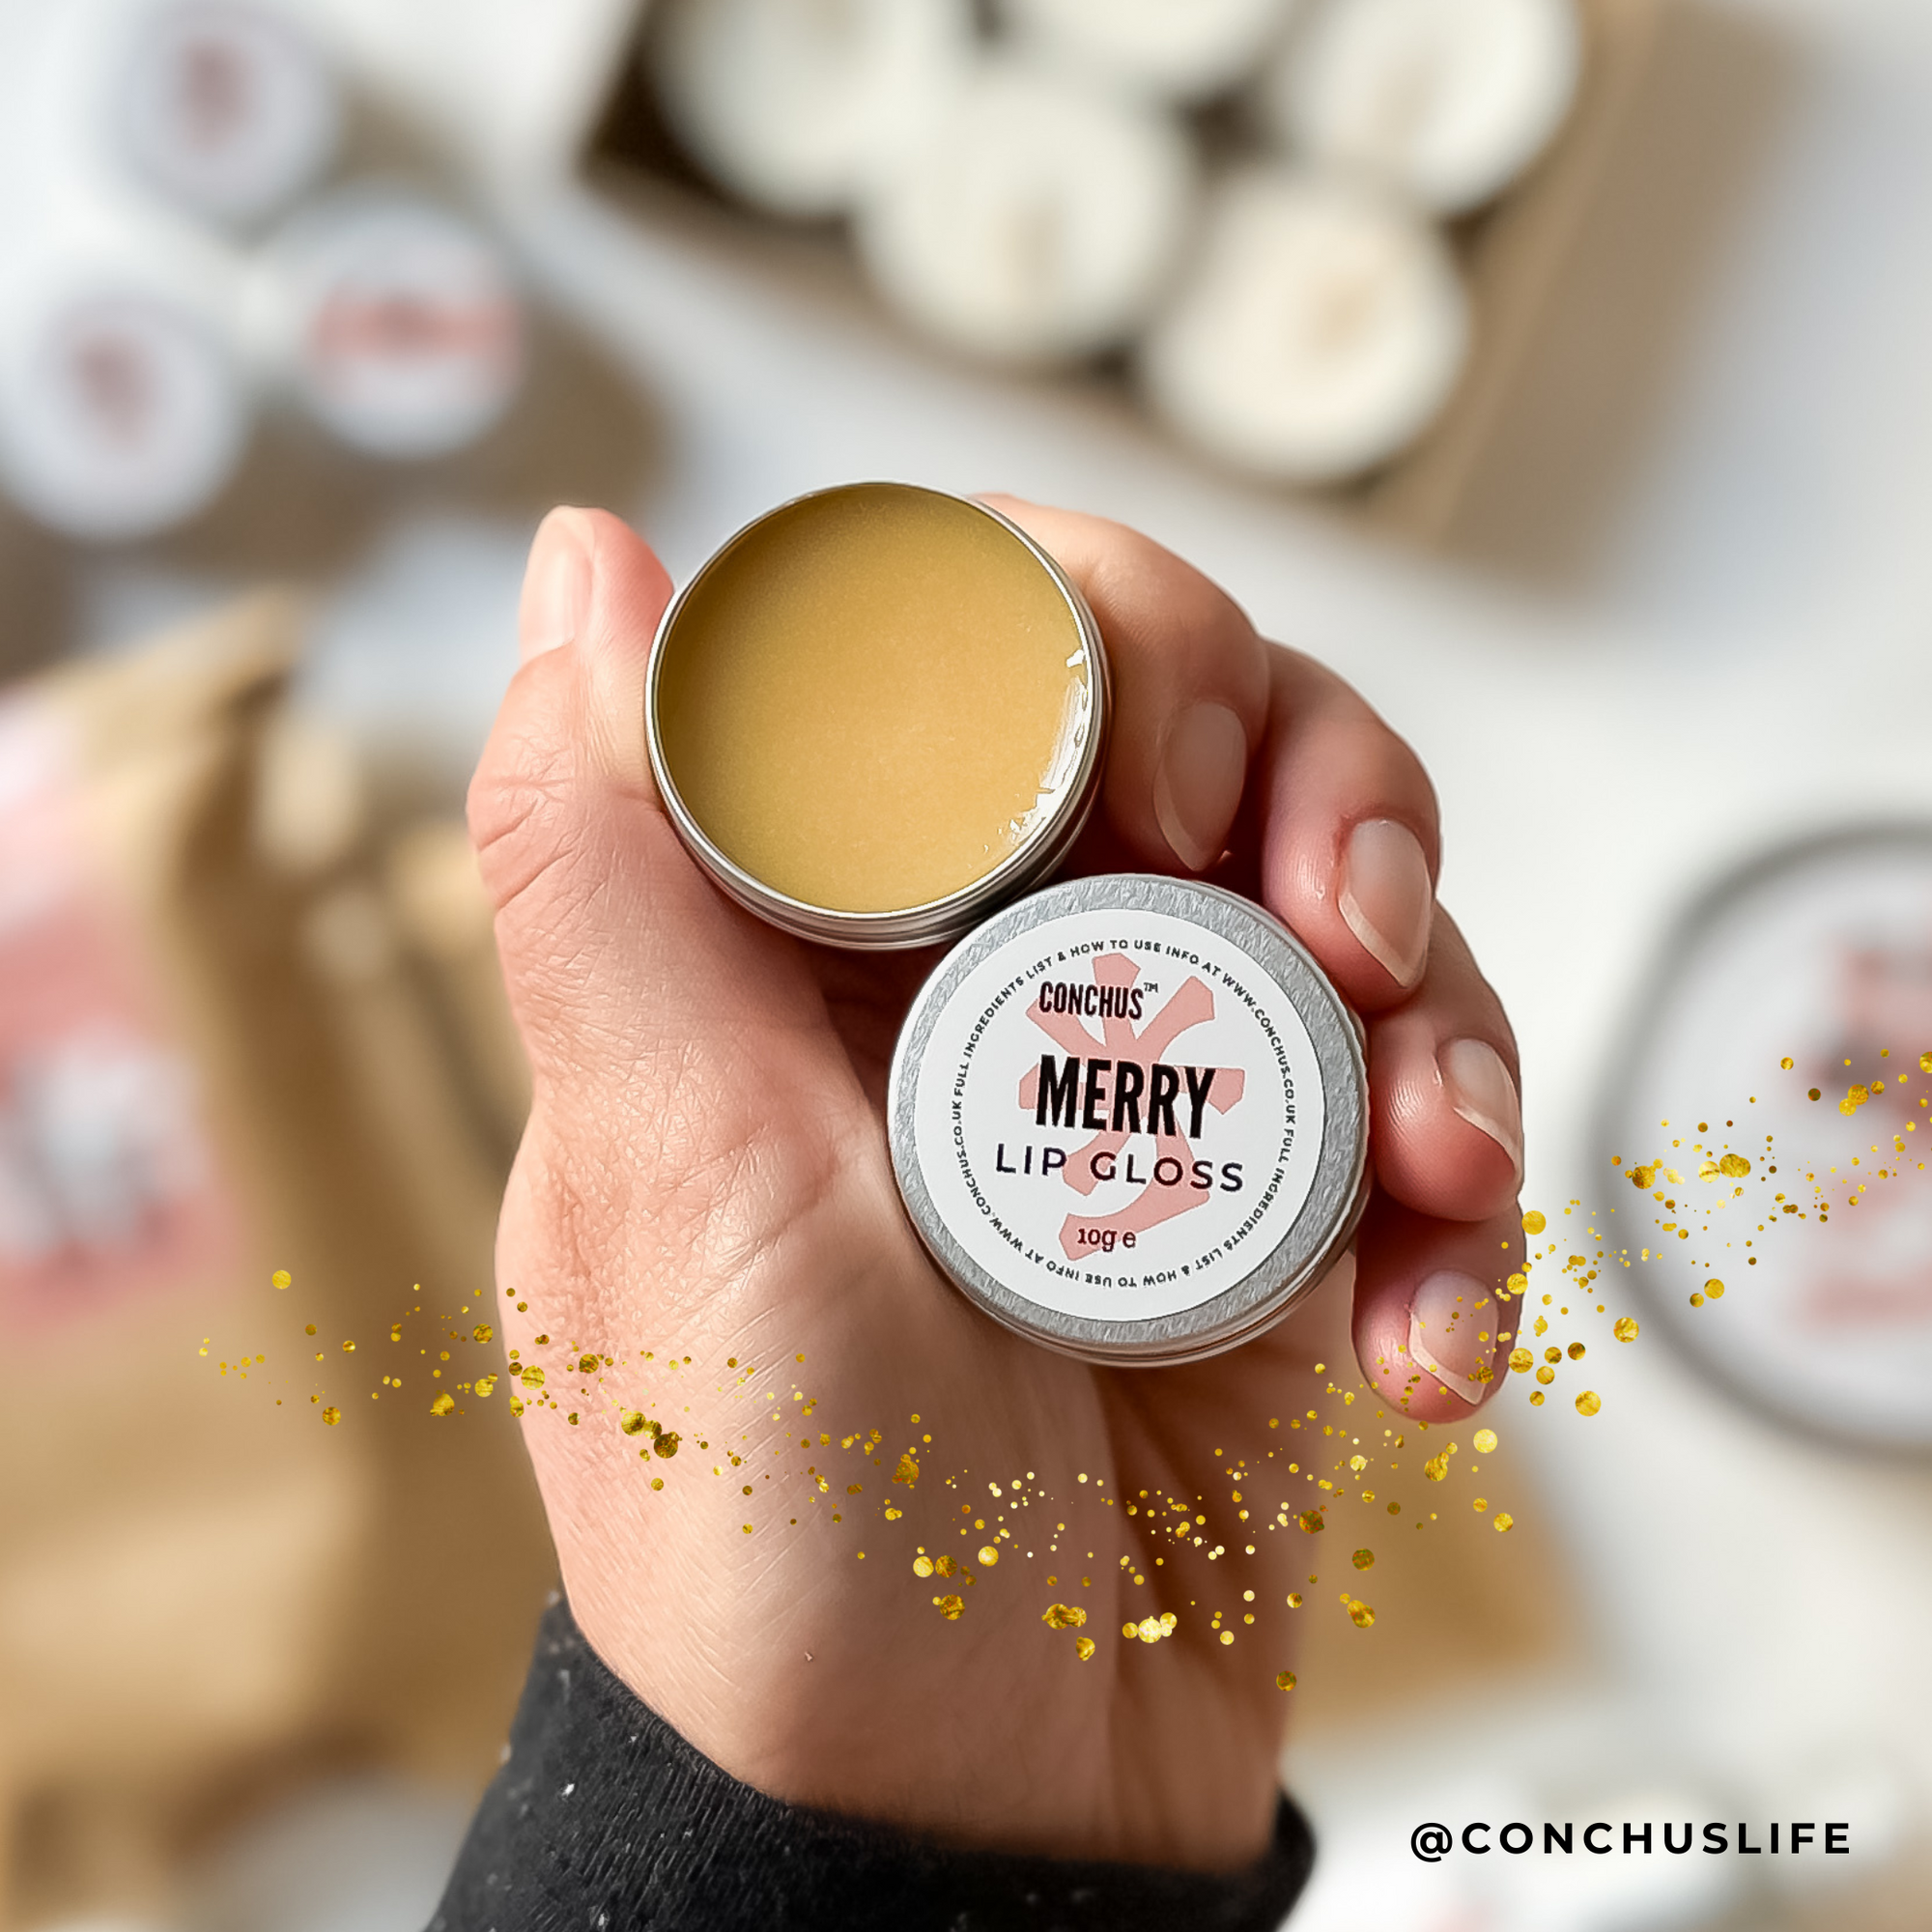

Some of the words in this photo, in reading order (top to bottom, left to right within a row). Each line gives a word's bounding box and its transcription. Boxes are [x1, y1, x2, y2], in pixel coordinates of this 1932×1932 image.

[954, 1063, 968, 1097] FULL
[964, 977, 1024, 1059] INGREDIENTS
[1026, 956, 1052, 980] LIST
[1058, 952, 1066, 962] &
[1070, 941, 1104, 957] HOW
[1110, 940, 1128, 949] TO
[1134, 940, 1161, 952] USE
[1165, 946, 1199, 964] INFO
[1202, 962, 1221, 976] AT
[1222, 974, 1295, 1124] WWW.CONCHUS.CO.UK
[1035, 1054, 1217, 1139] MERRY
[1278, 1128, 1294, 1163] FULL
[952, 1100, 1023, 1253] WWW.CONCHUS.CO.UK
[995, 1143, 1067, 1176] LIP
[1090, 1151, 1244, 1192] GLOSS
[1224, 1167, 1285, 1250] INGREDIENTS
[1076, 1228, 1118, 1253] 10g
[1025, 1249, 1044, 1264] AT
[1196, 1248, 1223, 1270] LIST
[1046, 1261, 1079, 1281] INFO
[1086, 1274, 1112, 1288] USE
[1143, 1270, 1177, 1287] HOW
[1180, 1265, 1190, 1276] &
[1119, 1277, 1137, 1288] TO
